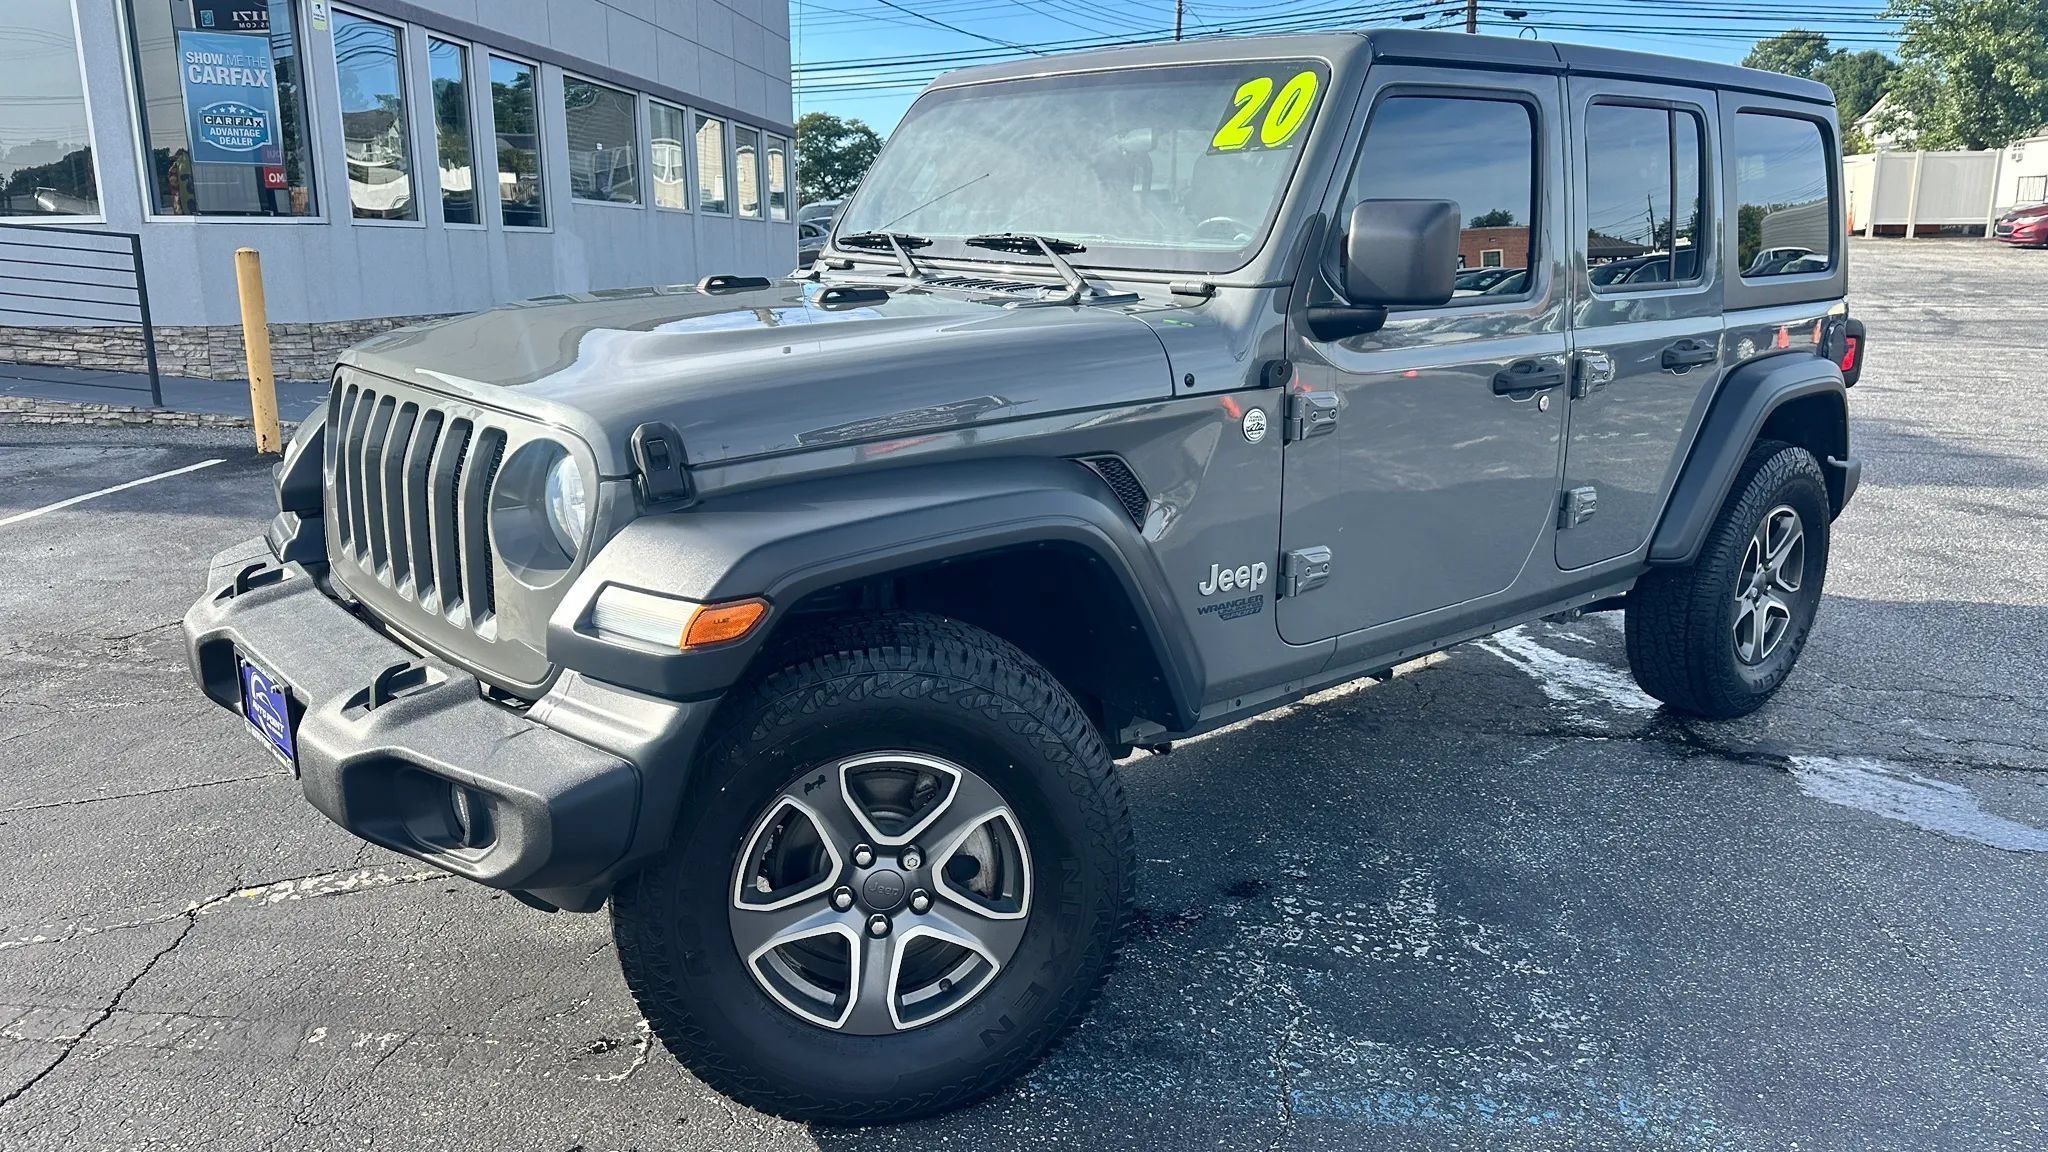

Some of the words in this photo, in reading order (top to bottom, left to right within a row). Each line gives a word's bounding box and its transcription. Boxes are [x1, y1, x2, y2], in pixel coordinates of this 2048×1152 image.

[186, 51, 223, 65] SHOW
[226, 55, 244, 67] ME
[245, 56, 267, 68] THE
[188, 65, 269, 88] CARFAX
[1212, 70, 1319, 150] 20
[204, 115, 264, 128] CARFAX
[210, 127, 261, 138] ADVANTAGE
[219, 136, 253, 146] DEALER
[1199, 561, 1267, 595] Jeep
[1197, 594, 1264, 615] WRANGLER
